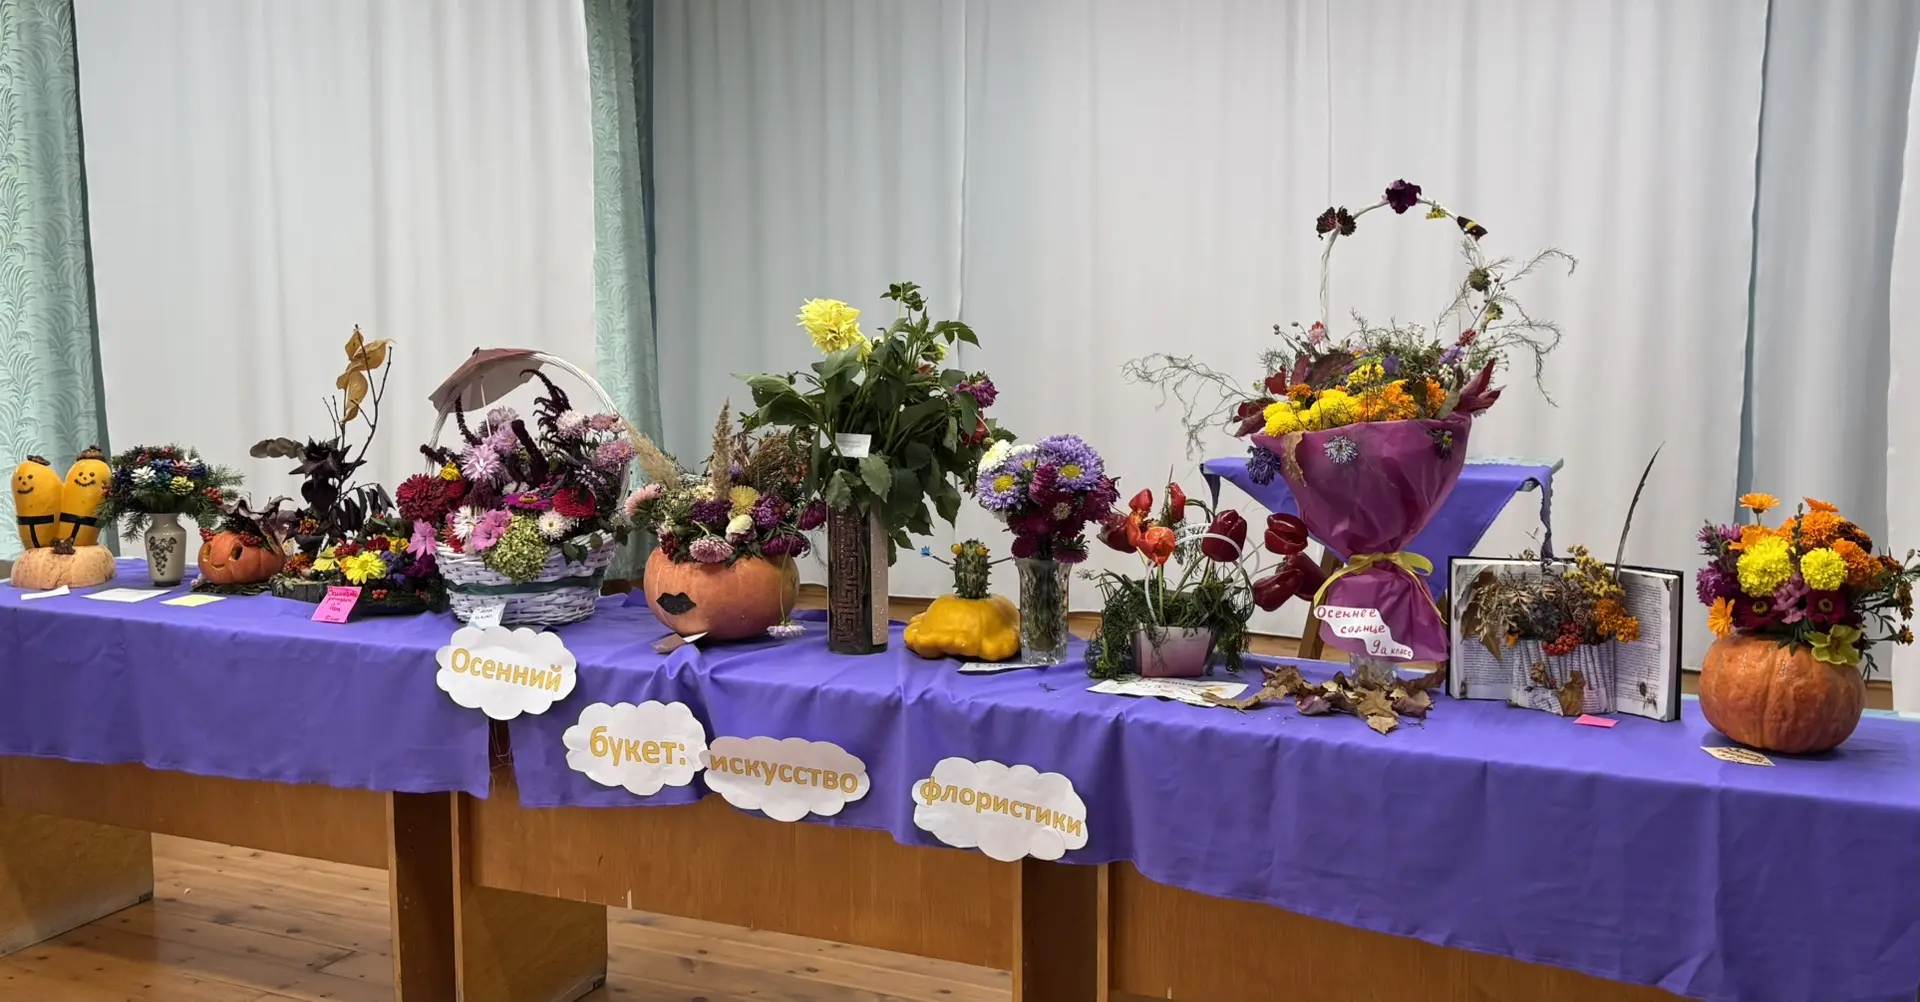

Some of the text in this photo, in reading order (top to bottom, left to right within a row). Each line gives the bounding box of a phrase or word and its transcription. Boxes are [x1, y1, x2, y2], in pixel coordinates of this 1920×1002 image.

[1316, 607, 1378, 618] Осеннее
[1340, 625, 1386, 634] солнце
[451, 648, 562, 692] Осенний
[589, 726, 686, 766] букет:
[709, 753, 859, 794] искусство
[920, 776, 1082, 837] флористики
